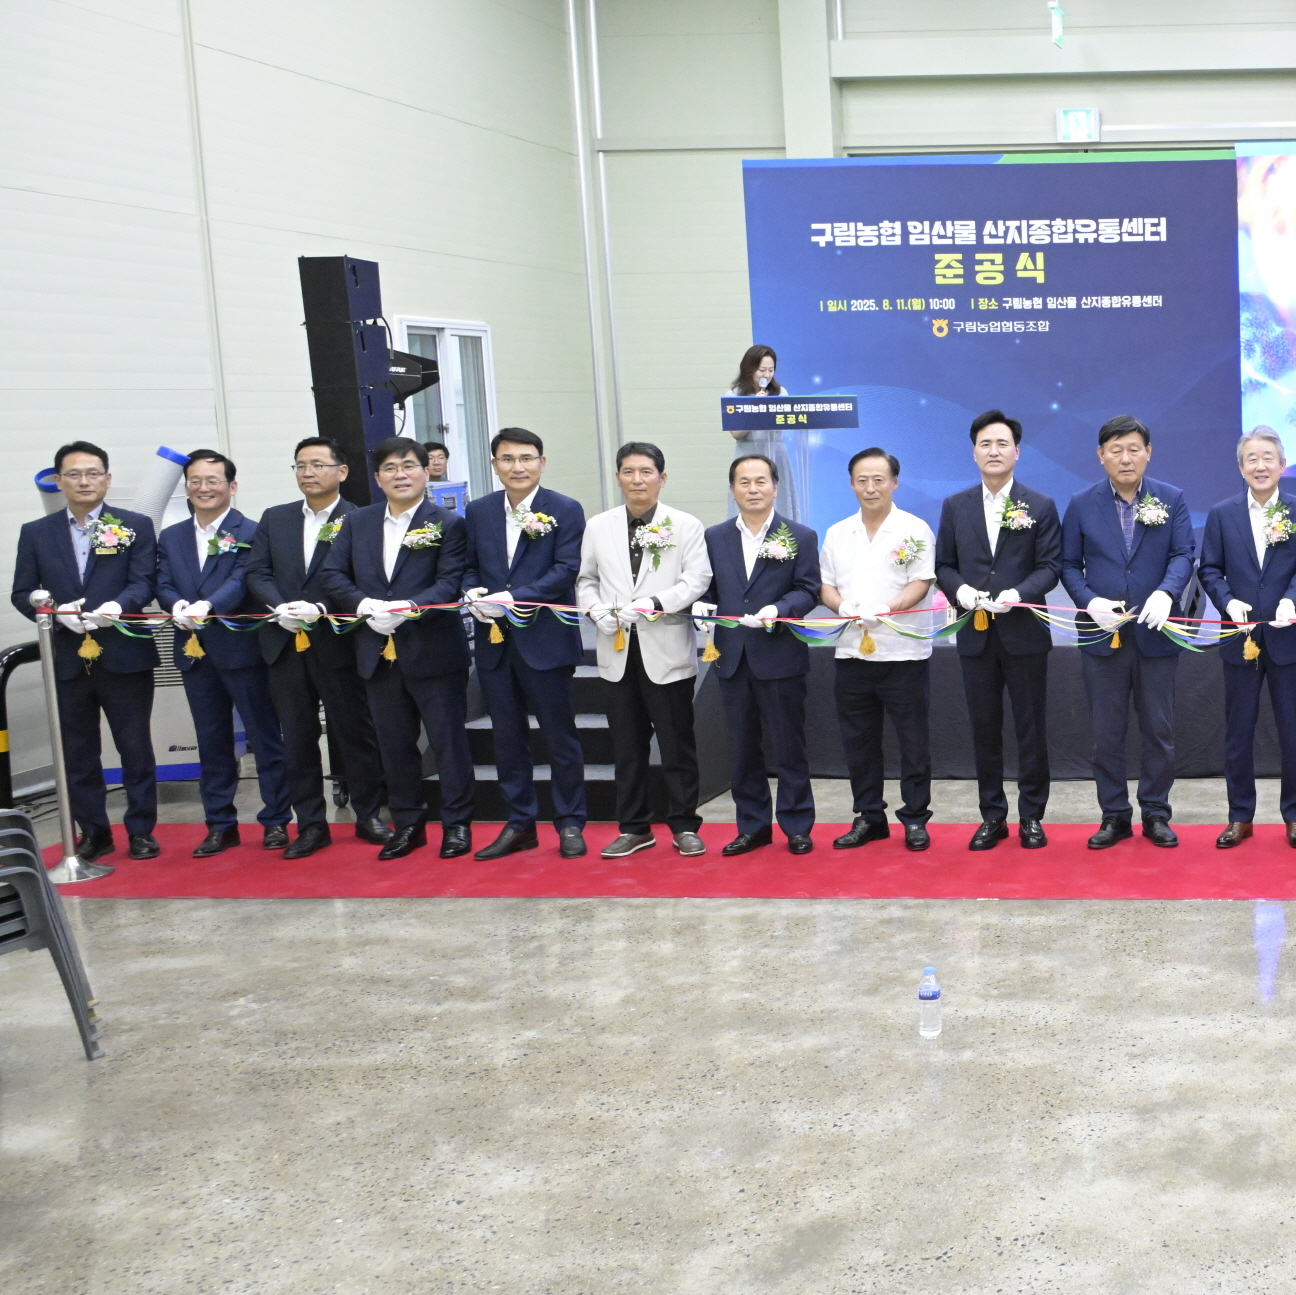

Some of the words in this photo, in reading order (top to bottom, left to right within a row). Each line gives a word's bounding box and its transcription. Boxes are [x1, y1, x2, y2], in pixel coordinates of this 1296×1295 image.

[810, 221, 901, 247] 구림농협
[907, 219, 976, 246] 임산물
[983, 217, 1167, 245] 산지종합유통센터
[827, 300, 847, 312] 일시
[851, 299, 879, 311] 2025.
[882, 299, 893, 311] 8.
[896, 298, 925, 311] 11.(월)
[929, 298, 955, 310] 10:00
[977, 298, 998, 310] 장소
[1002, 297, 1042, 310] 구림농협
[1046, 296, 1077, 309] 임산물
[1081, 295, 1163, 308] 산지종합유통센터
[952, 320, 1050, 333] 구림농업협동조합
[736, 404, 767, 413] 구림농협
[793, 402, 853, 412] 산지종합유통센터
